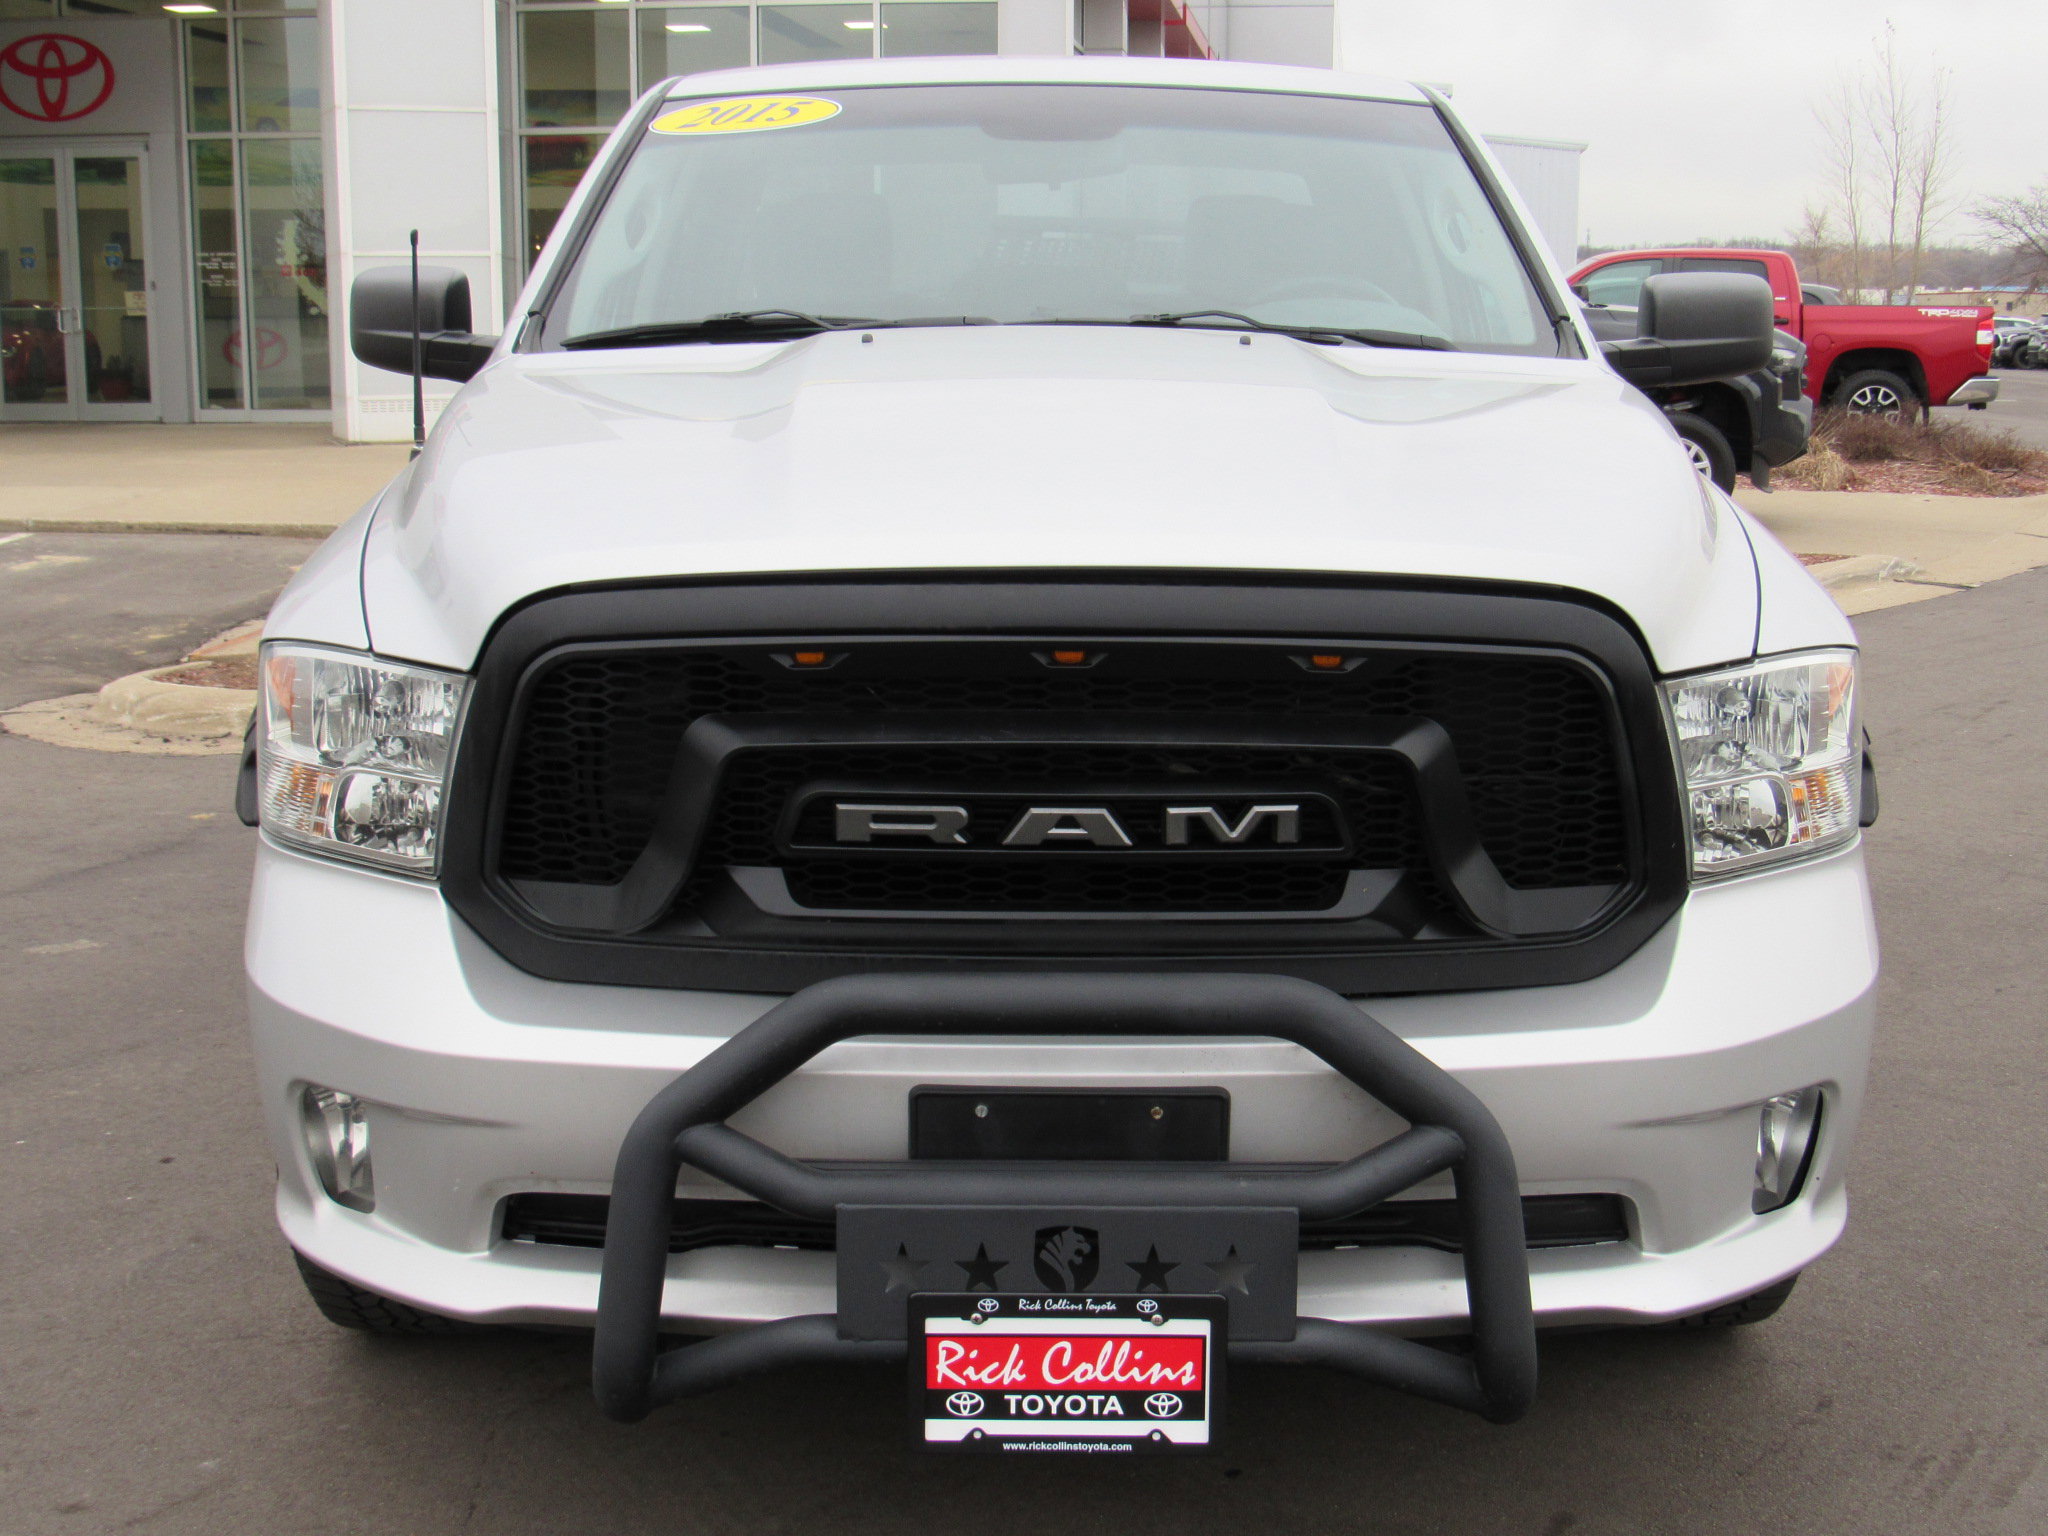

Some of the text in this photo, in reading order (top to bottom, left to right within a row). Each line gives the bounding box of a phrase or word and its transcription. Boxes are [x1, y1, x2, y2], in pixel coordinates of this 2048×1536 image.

[675, 101, 814, 129] 2015
[1917, 308, 1949, 318] TRD
[835, 803, 1300, 846] RAM
[1018, 1298, 1117, 1313] Rick Collins Toyota
[935, 1340, 1197, 1386] Rick Collins
[1003, 1394, 1125, 1416] TOYOTA
[1002, 1440, 1133, 1453] www.rickcollinstoyota.com
